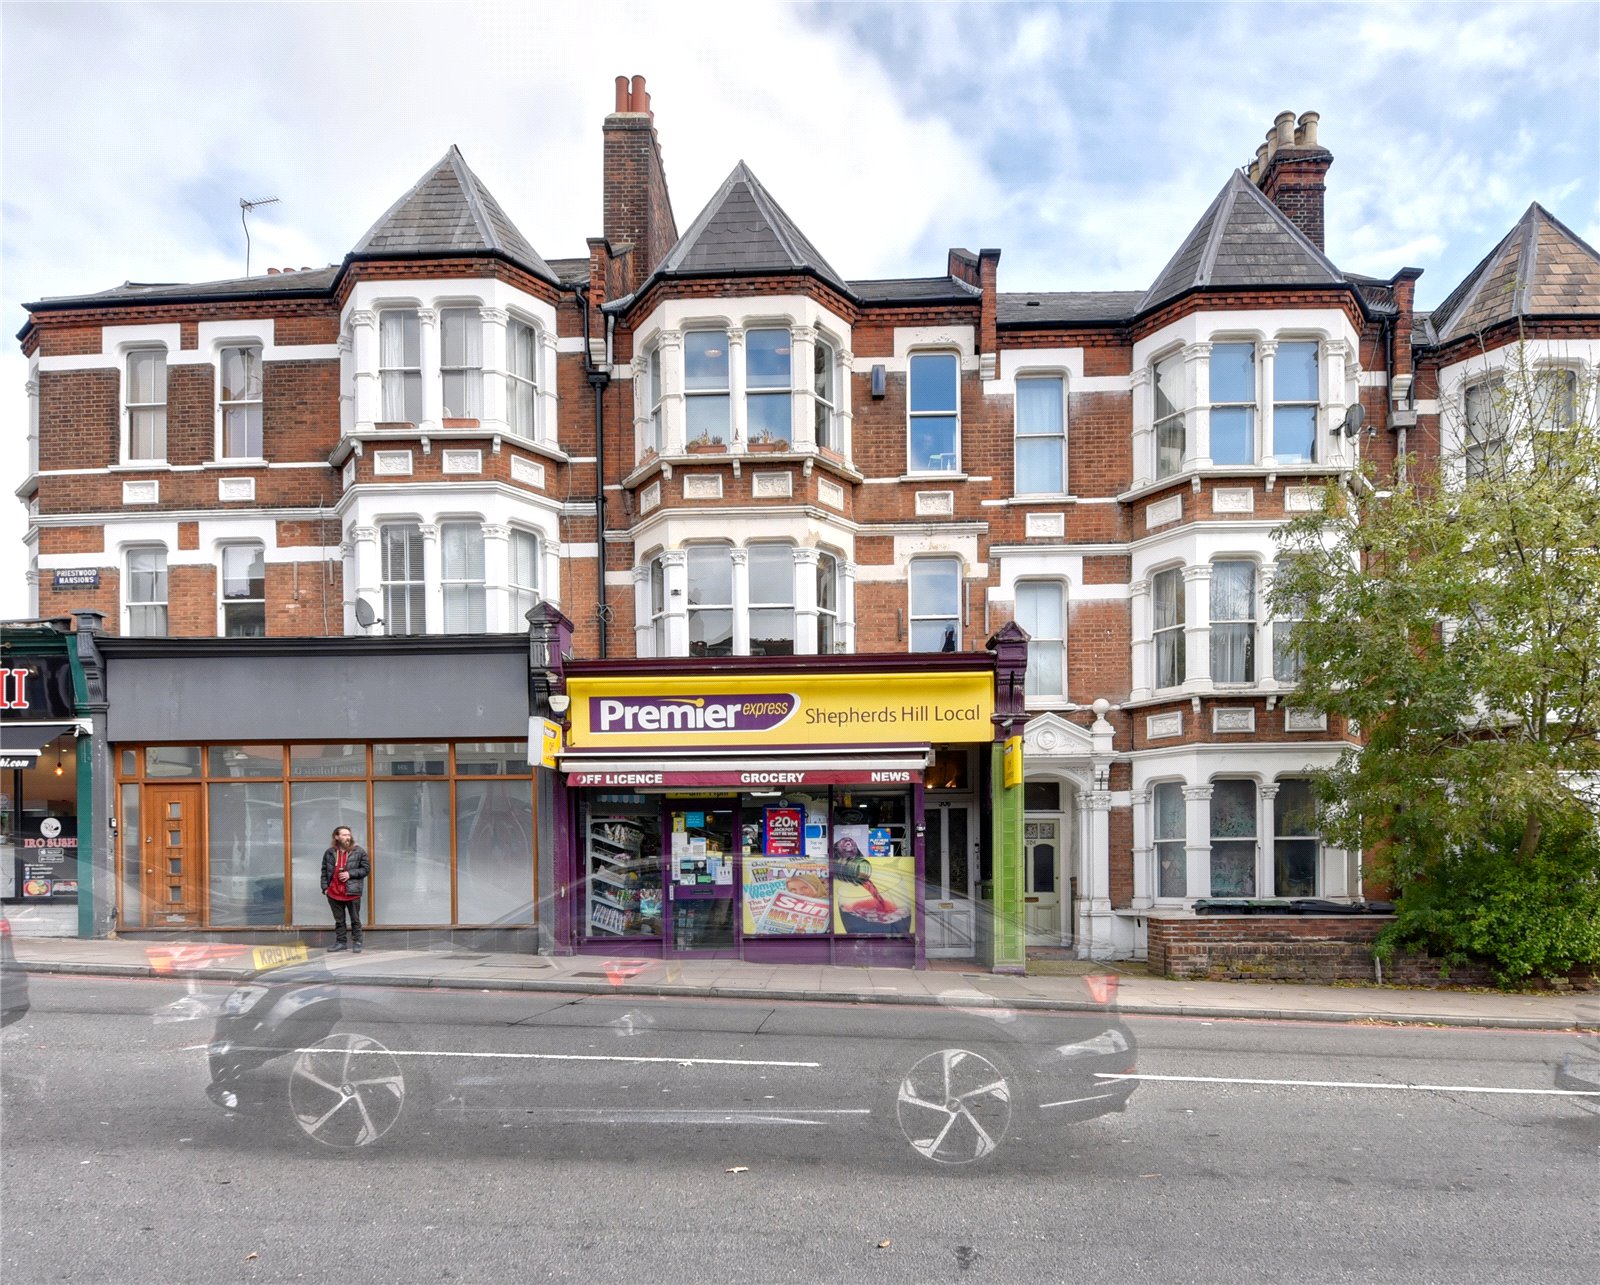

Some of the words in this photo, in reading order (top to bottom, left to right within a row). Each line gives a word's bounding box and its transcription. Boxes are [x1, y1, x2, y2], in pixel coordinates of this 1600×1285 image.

[56, 569, 97, 577] PRIESTWOOD
[59, 576, 95, 584] MANSIONS
[600, 698, 742, 731] Premier
[742, 701, 789, 718] express
[805, 706, 897, 727] Shepherds
[901, 705, 929, 722] Hill
[935, 704, 980, 721] Local
[576, 774, 602, 785] OFF
[605, 773, 663, 784] LICENCE
[740, 772, 805, 783] GROCERY
[871, 771, 910, 782] NEWS
[770, 816, 798, 828] £20M
[24, 838, 46, 848] IRO
[775, 894, 830, 917] Sun
